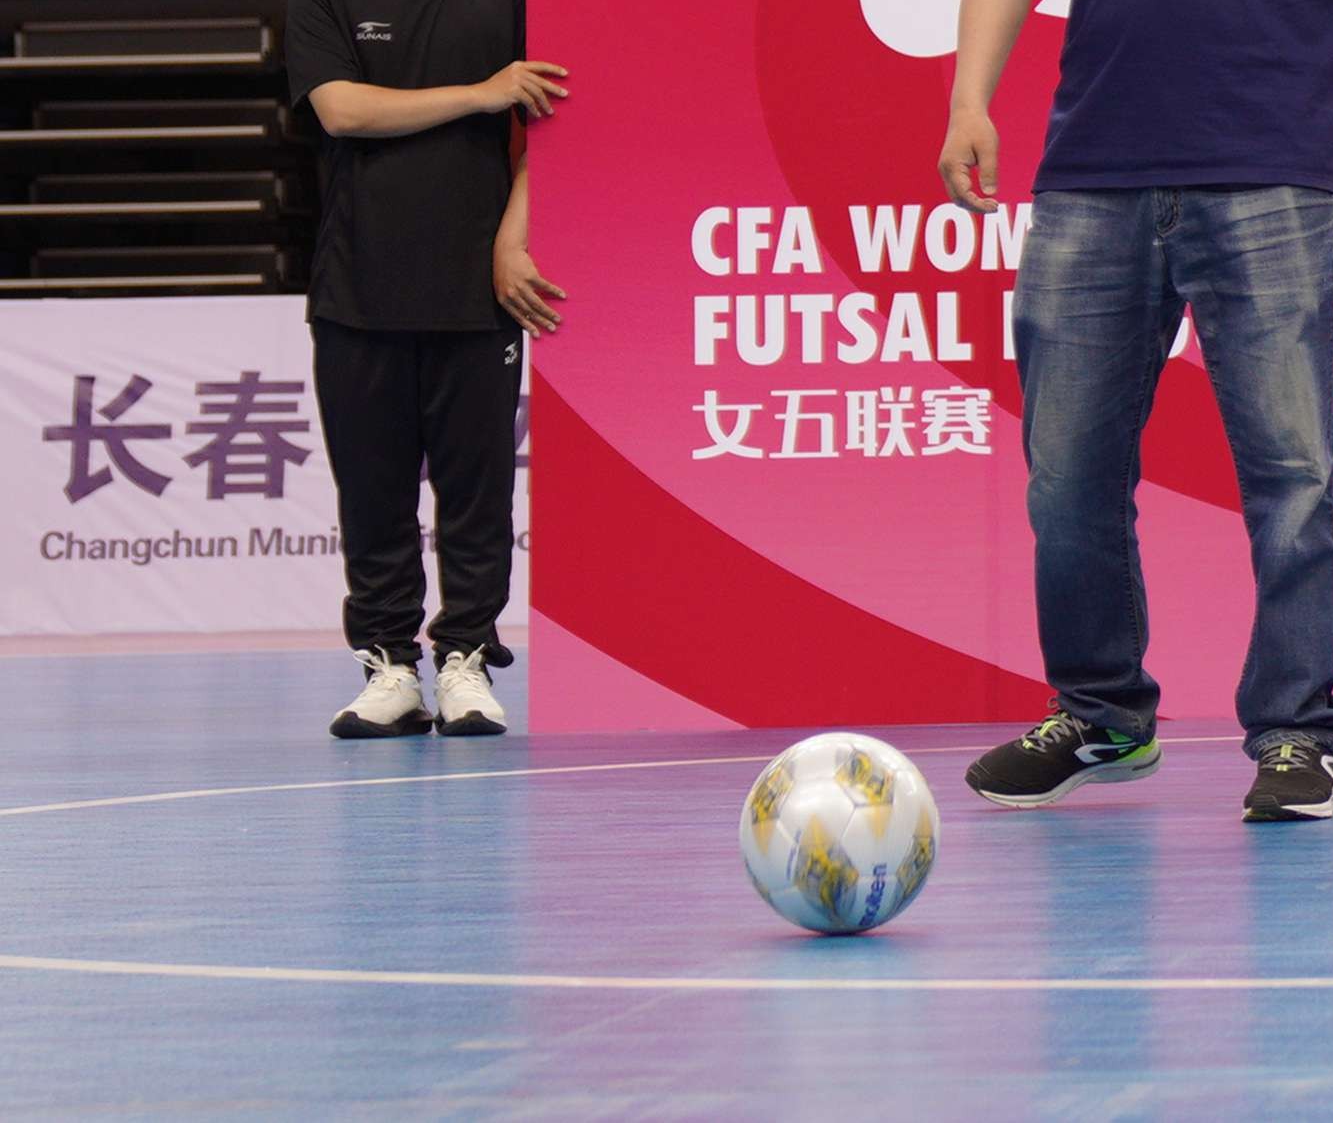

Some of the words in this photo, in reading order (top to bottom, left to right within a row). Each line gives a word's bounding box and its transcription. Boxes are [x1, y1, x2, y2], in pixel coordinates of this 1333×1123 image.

[690, 206, 822, 276] CFA
[693, 291, 973, 366] FUTSAL
[691, 385, 993, 460] 女五联赛
[39, 529, 238, 566] Changchun
